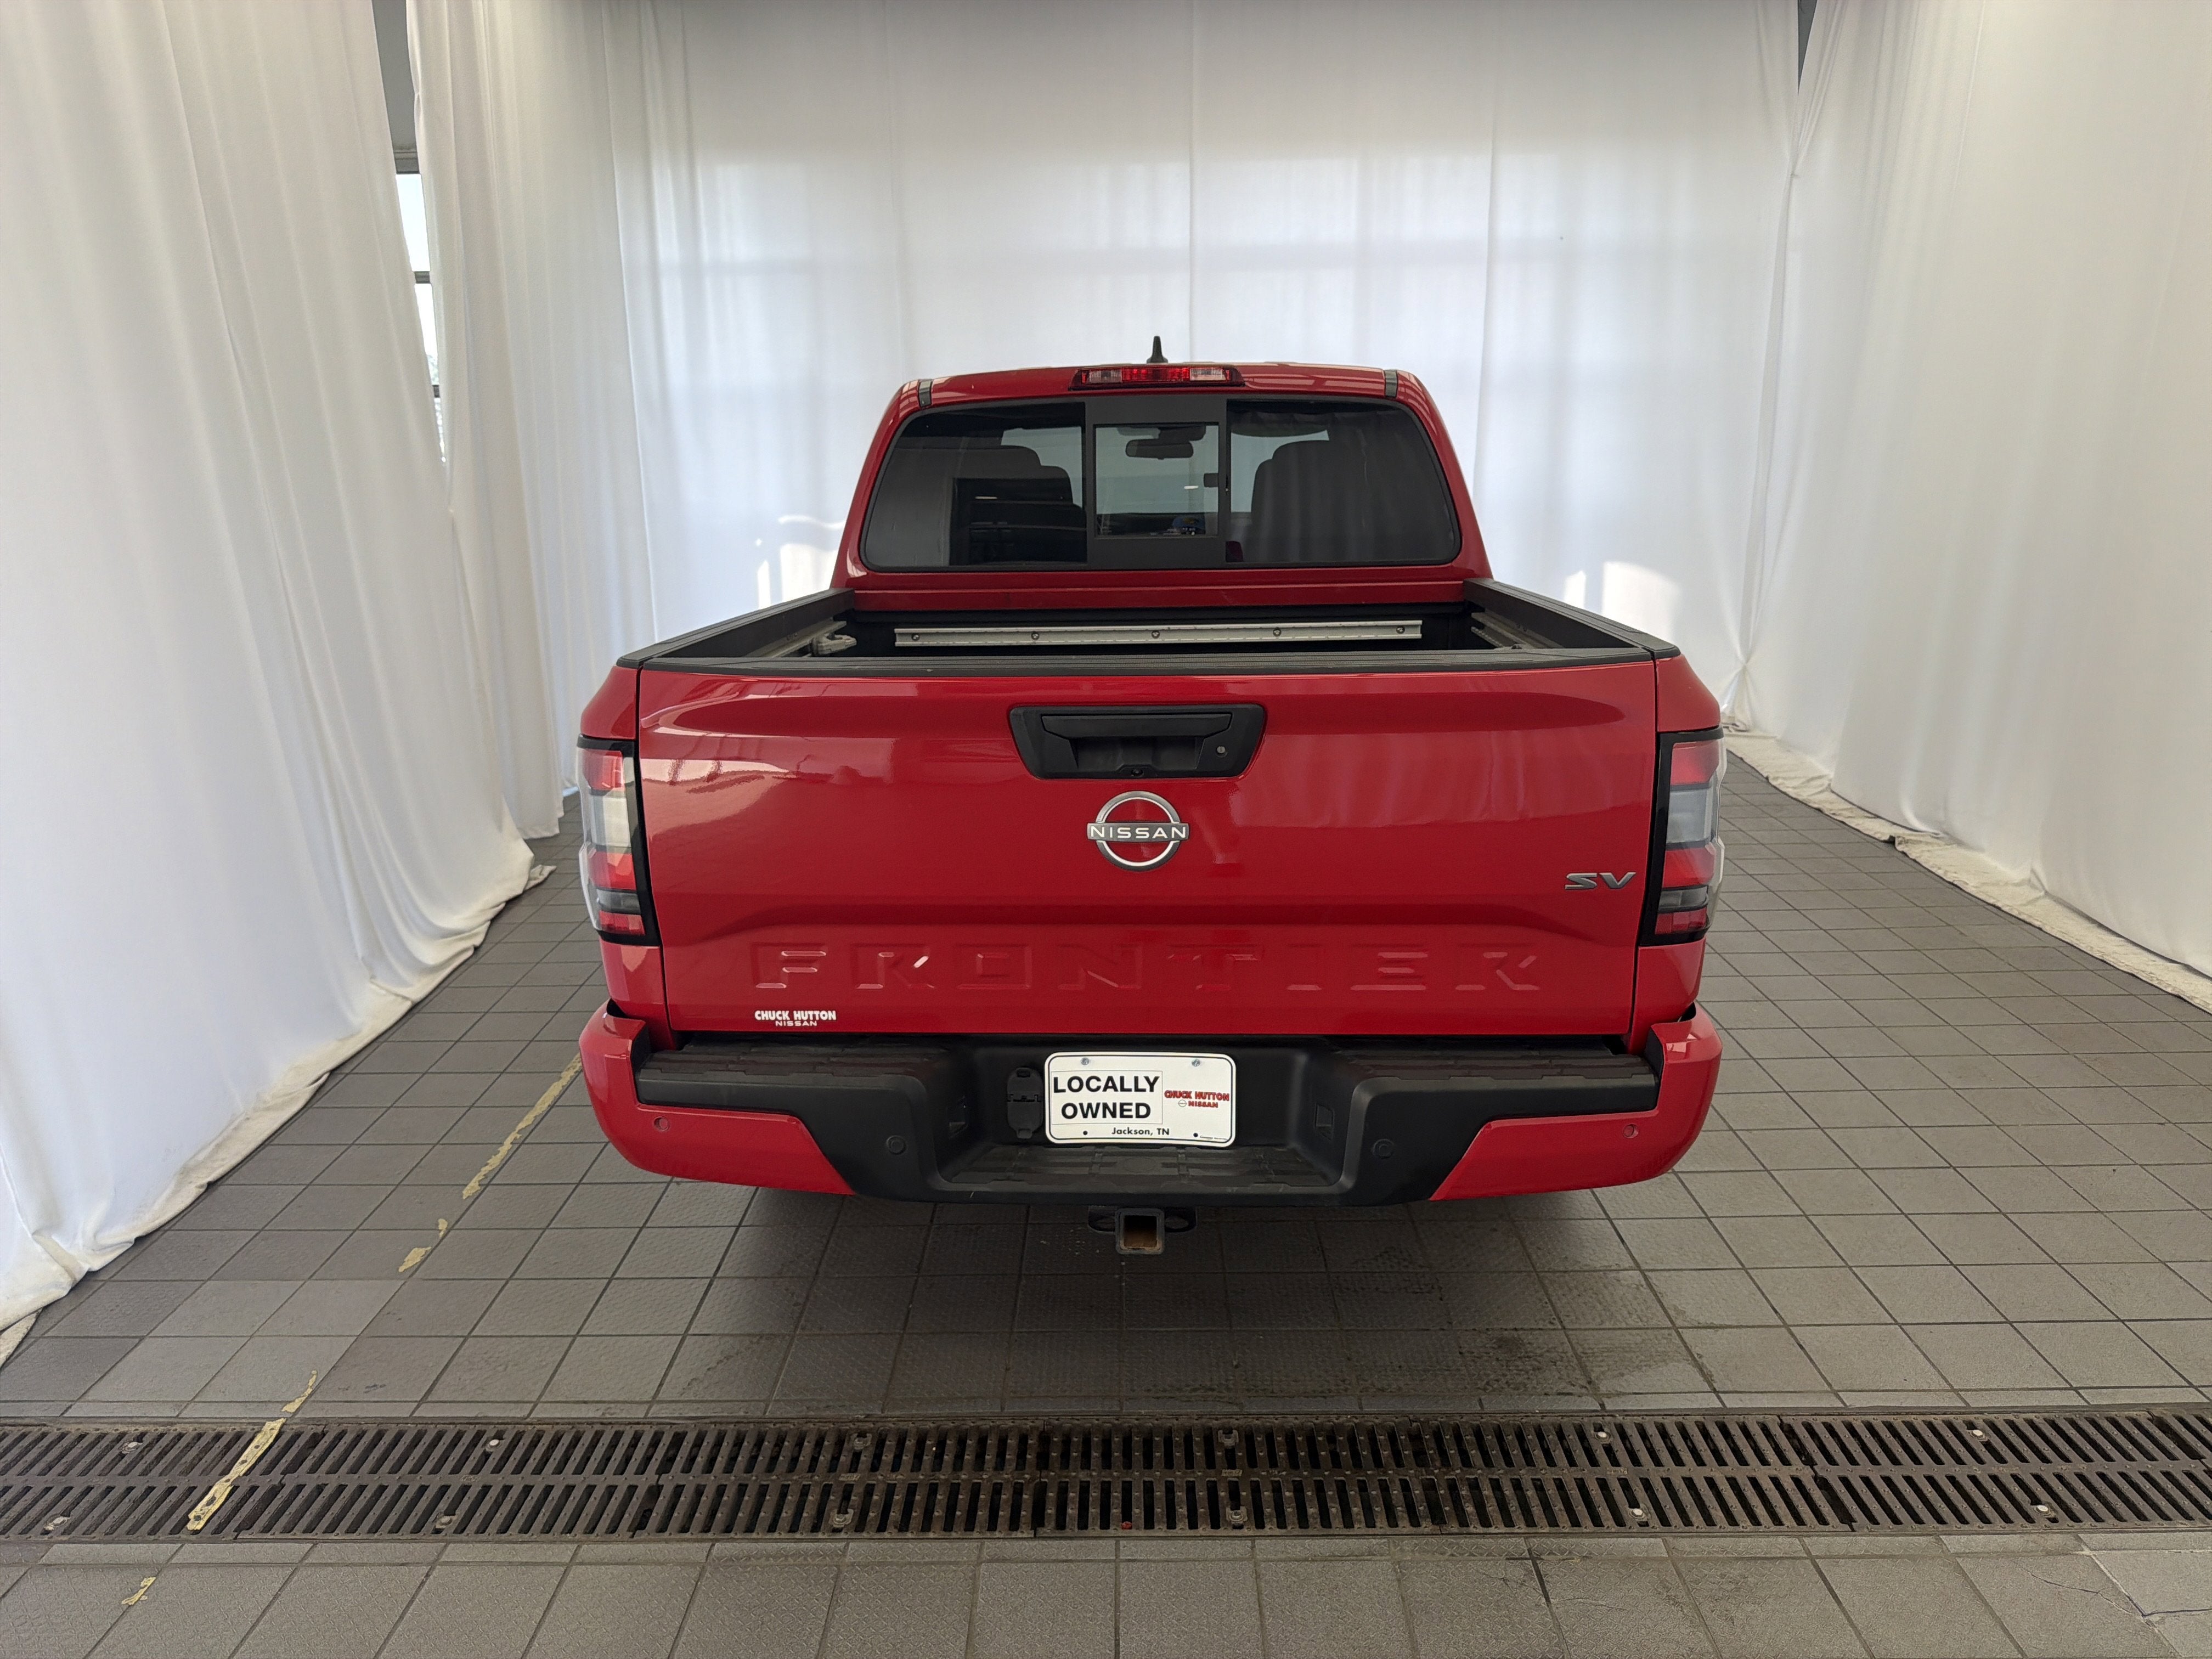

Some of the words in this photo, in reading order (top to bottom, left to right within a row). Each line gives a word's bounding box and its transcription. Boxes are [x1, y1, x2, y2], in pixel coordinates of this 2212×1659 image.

[1090, 826, 1186, 839] NISSAN
[1565, 872, 1637, 890] SV
[754, 1010, 790, 1020] CHUCK
[793, 1010, 837, 1020] HUTTON
[1053, 1075, 1160, 1093] LOCALLY
[1164, 1090, 1193, 1099] CHUCK
[1194, 1091, 1229, 1101] HUTTON
[1061, 1102, 1151, 1119] OWNED
[1111, 1127, 1153, 1136] Jackson,
